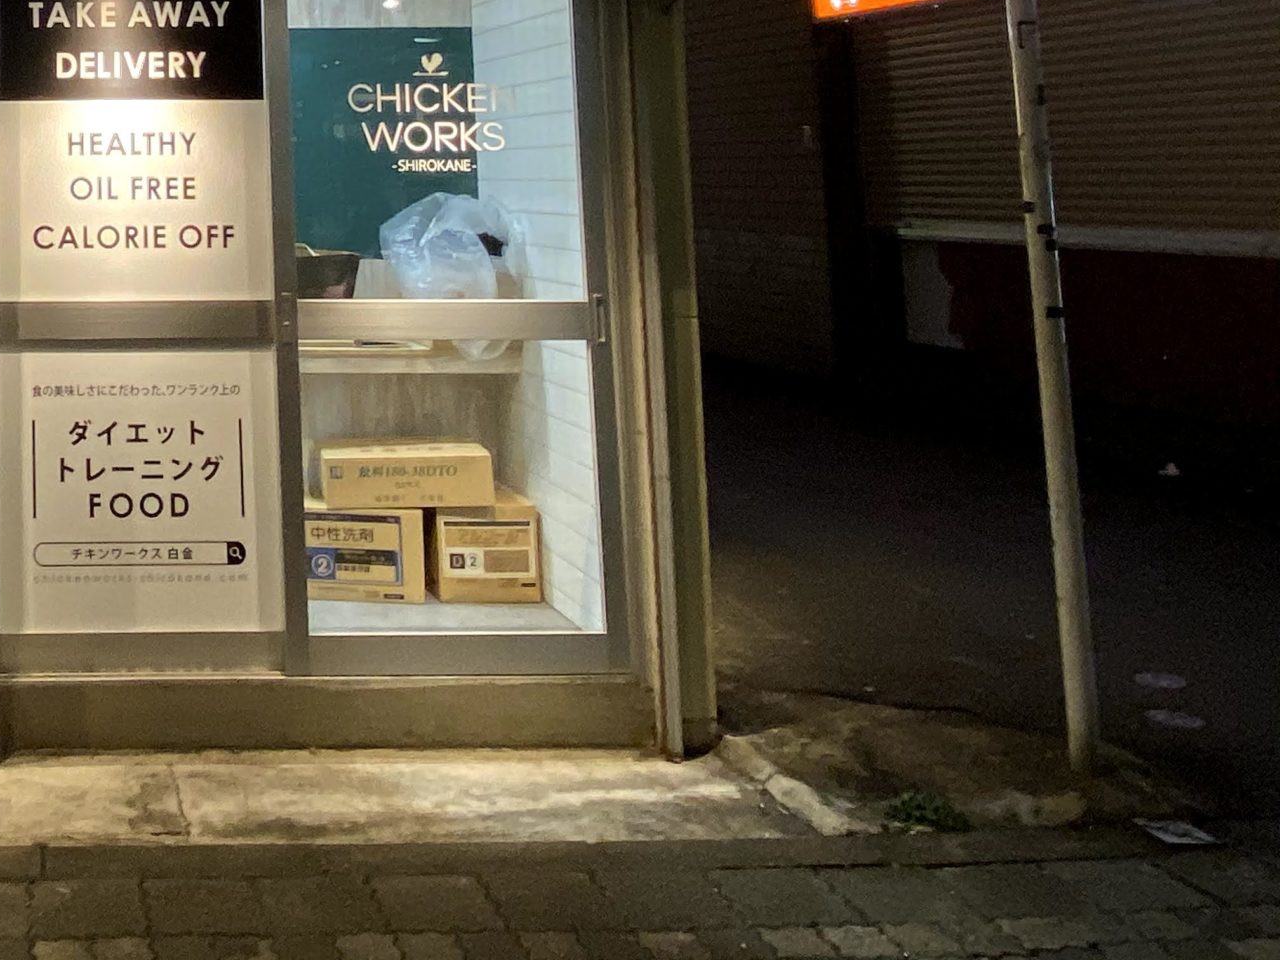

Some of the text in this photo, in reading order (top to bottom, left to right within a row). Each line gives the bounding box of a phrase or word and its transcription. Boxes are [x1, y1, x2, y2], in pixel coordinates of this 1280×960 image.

[28, 0, 231, 29] TAKE AWAY
[55, 51, 208, 80] DELIVERY
[347, 82, 516, 114] CHICKEN
[67, 131, 197, 157] HEALTHY
[360, 121, 506, 152] WORKS
[69, 176, 197, 201] OIL FREE
[32, 224, 235, 250] CALORIE OFF
[67, 419, 207, 446] ダイエット
[57, 455, 225, 483] トレーニング
[88, 492, 191, 519] FOOD
[310, 525, 375, 544] 中性洗剤
[70, 547, 163, 561] チキンワークス
